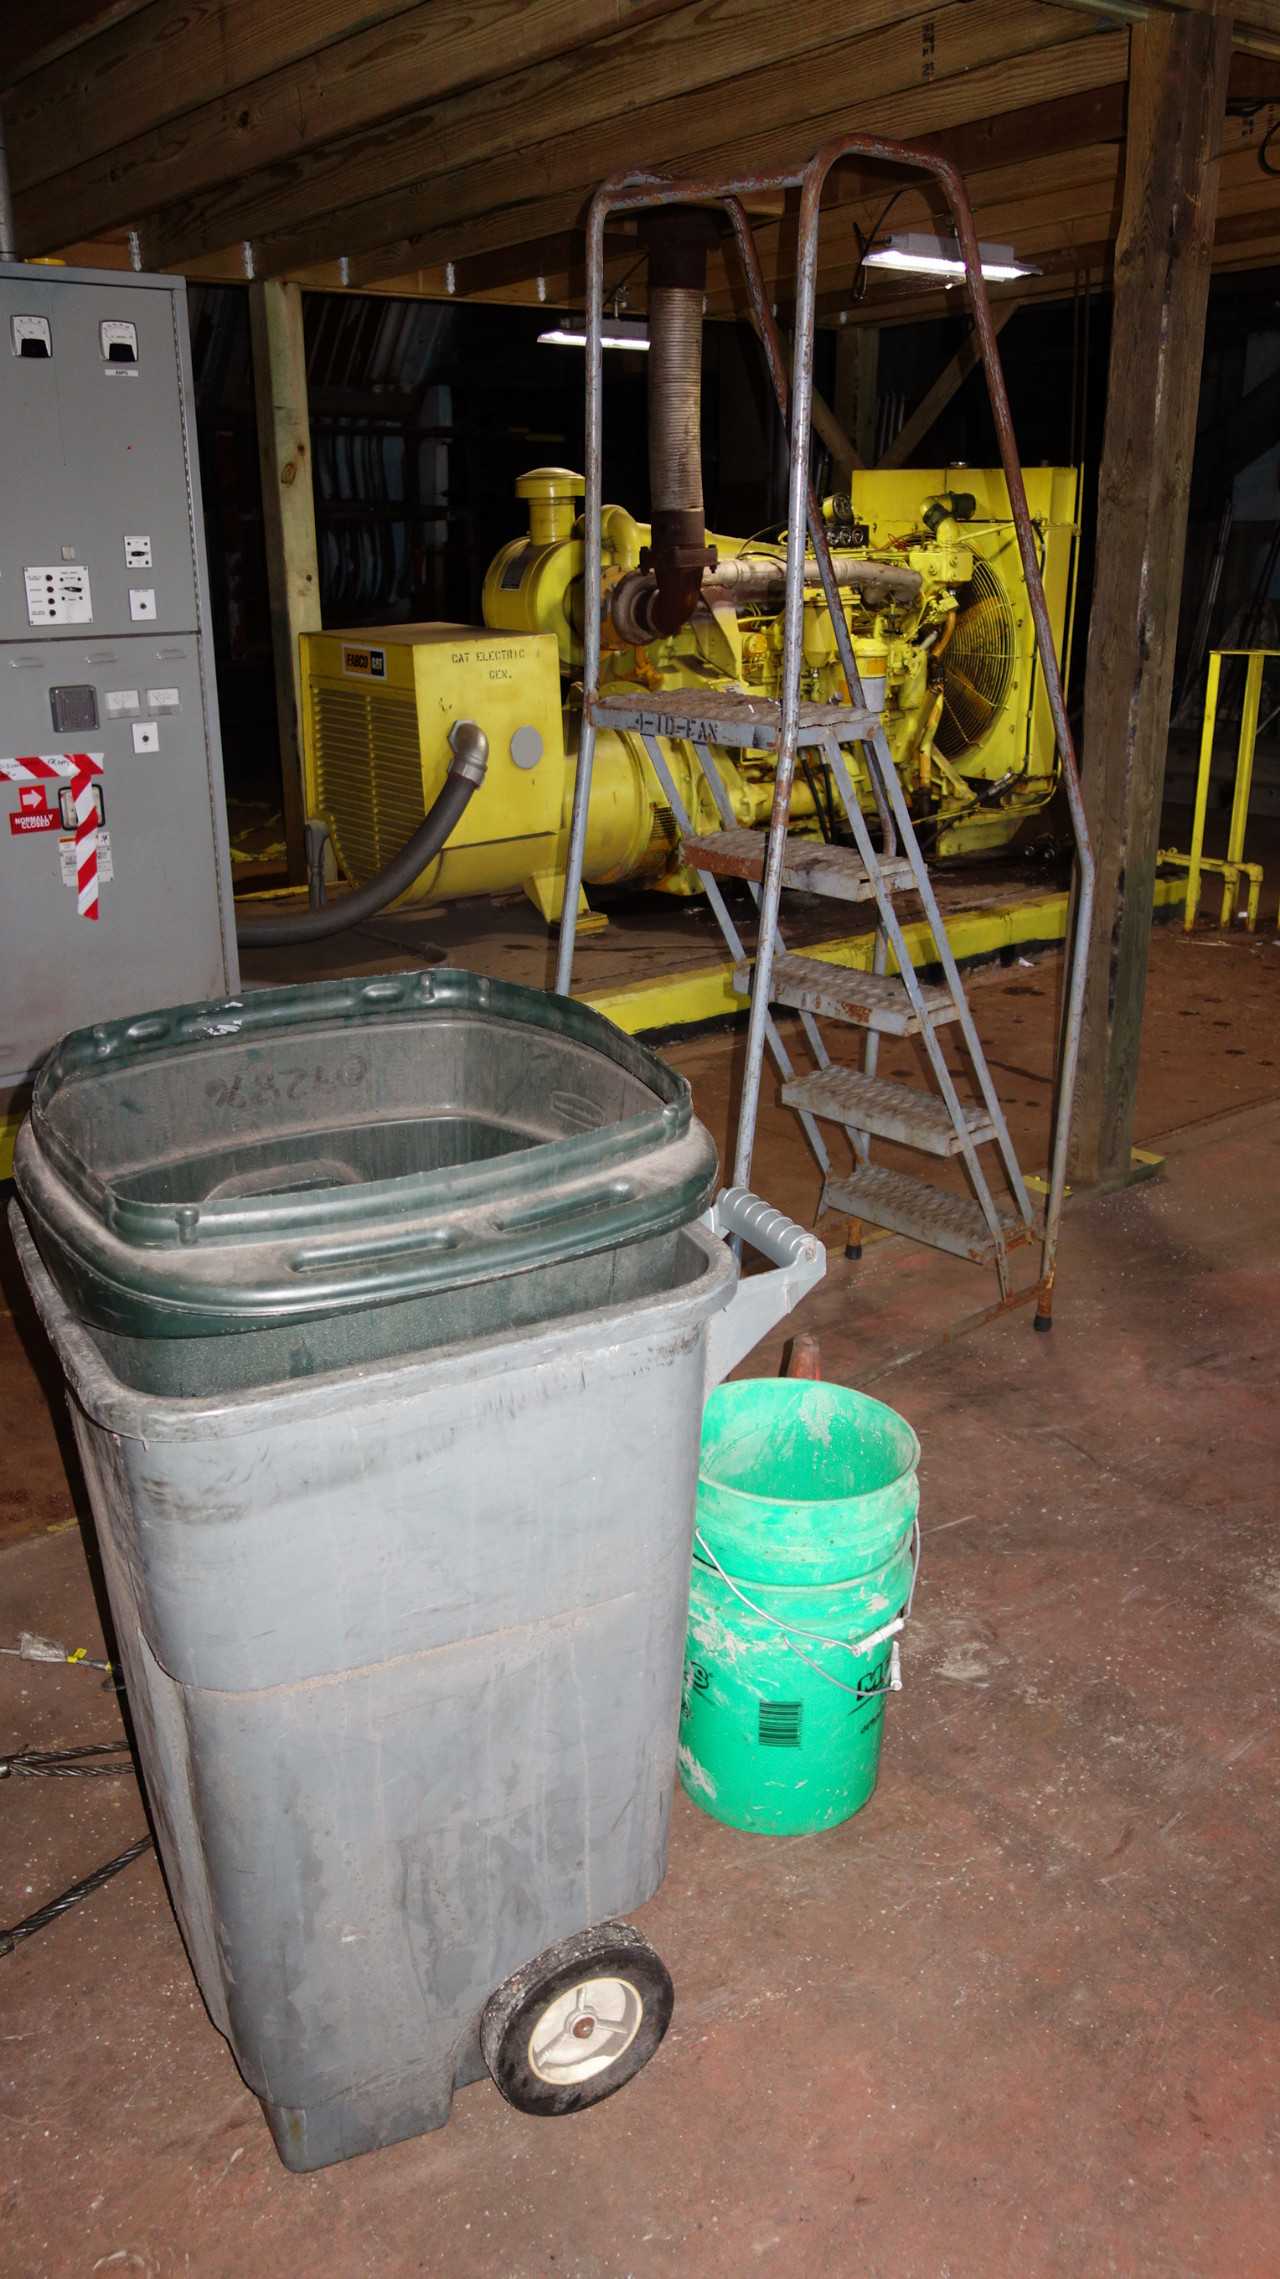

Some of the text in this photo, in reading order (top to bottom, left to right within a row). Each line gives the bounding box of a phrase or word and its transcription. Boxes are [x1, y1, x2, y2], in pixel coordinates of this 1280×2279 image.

[451, 652, 470, 664] CAT
[476, 649, 525, 662] ELECTRIC
[15, 814, 54, 825] NORMALLY
[21, 820, 51, 830] CLOSED
